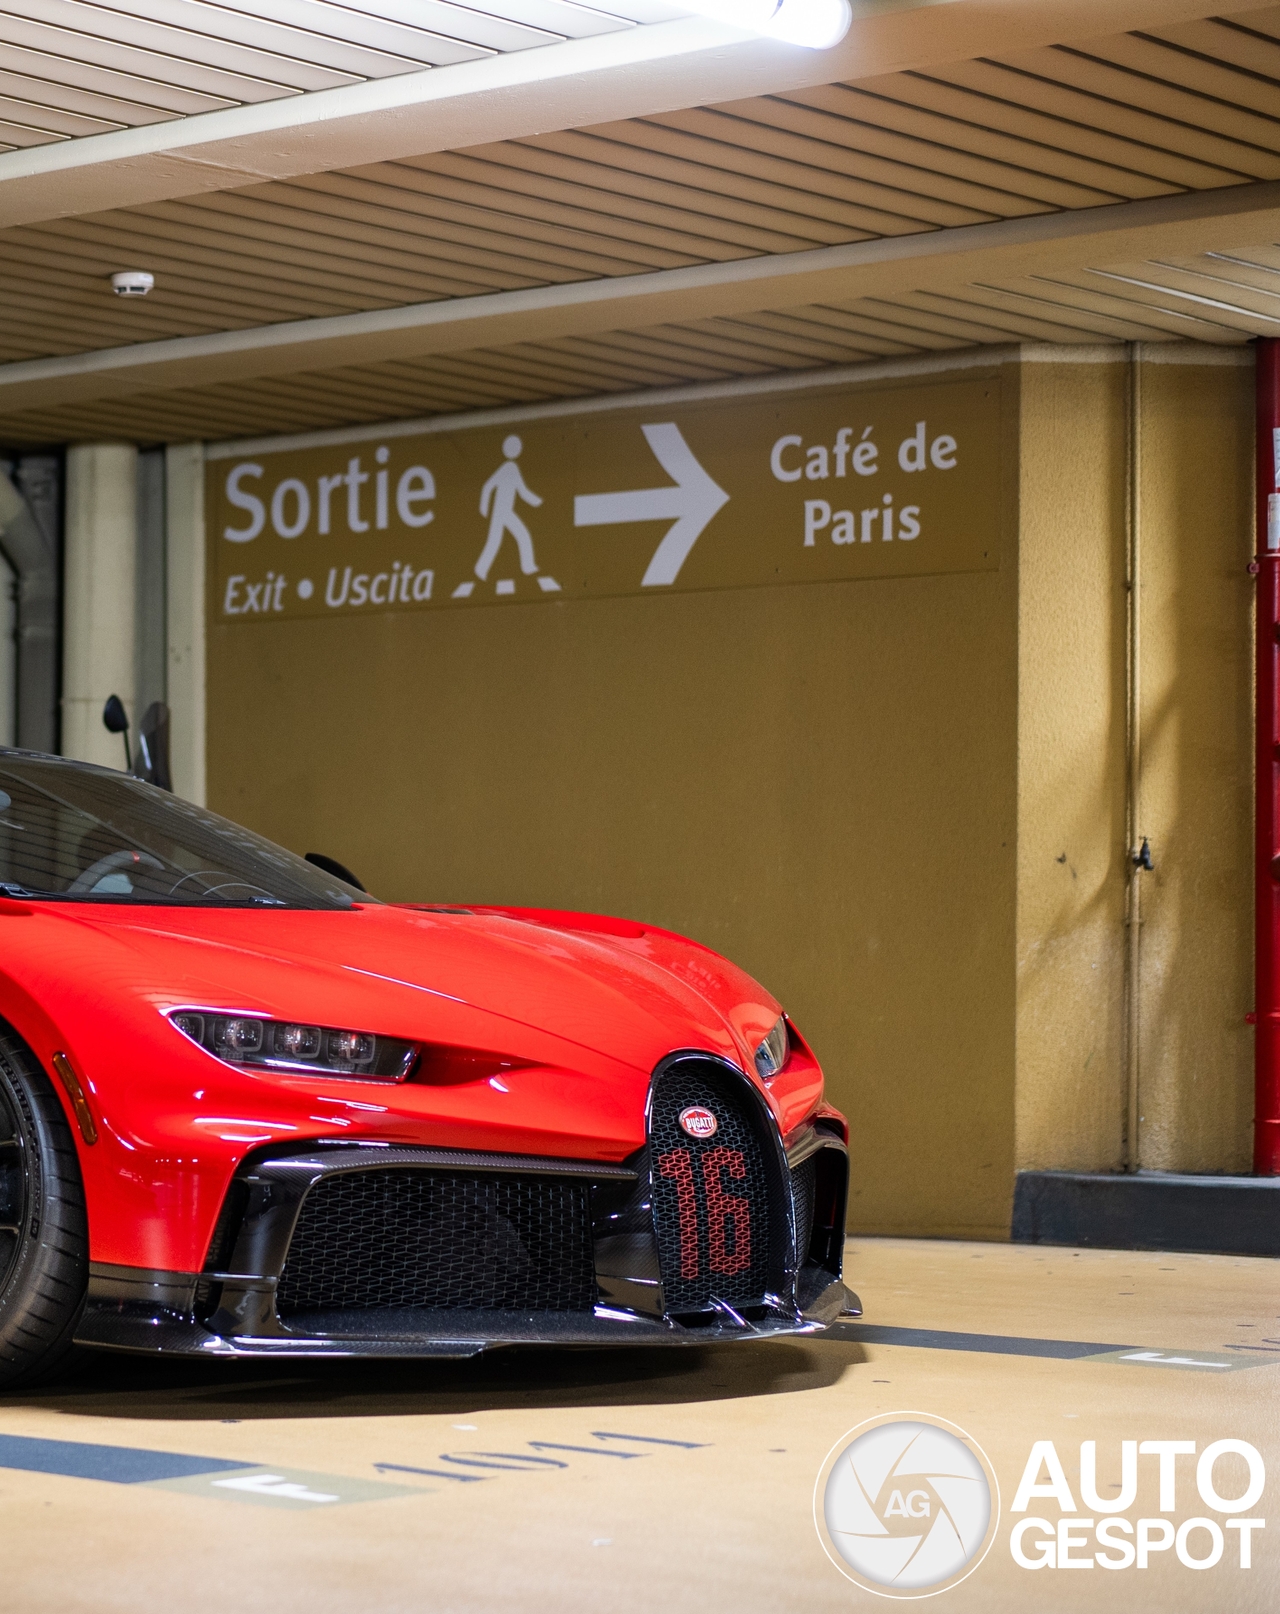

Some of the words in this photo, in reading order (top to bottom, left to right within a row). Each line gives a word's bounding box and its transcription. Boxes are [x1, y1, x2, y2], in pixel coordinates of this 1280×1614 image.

[770, 426, 879, 483] Café
[897, 421, 959, 473] de
[222, 445, 437, 544] Sortie
[803, 493, 922, 547] Paris
[223, 570, 287, 615] Exit
[325, 561, 435, 608] Uscita
[685, 1116, 715, 1130] BUGATTI
[658, 1147, 751, 1279] 16
[1118, 1351, 1233, 1368] F
[210, 1473, 340, 1505] F
[372, 1430, 713, 1482] 1011
